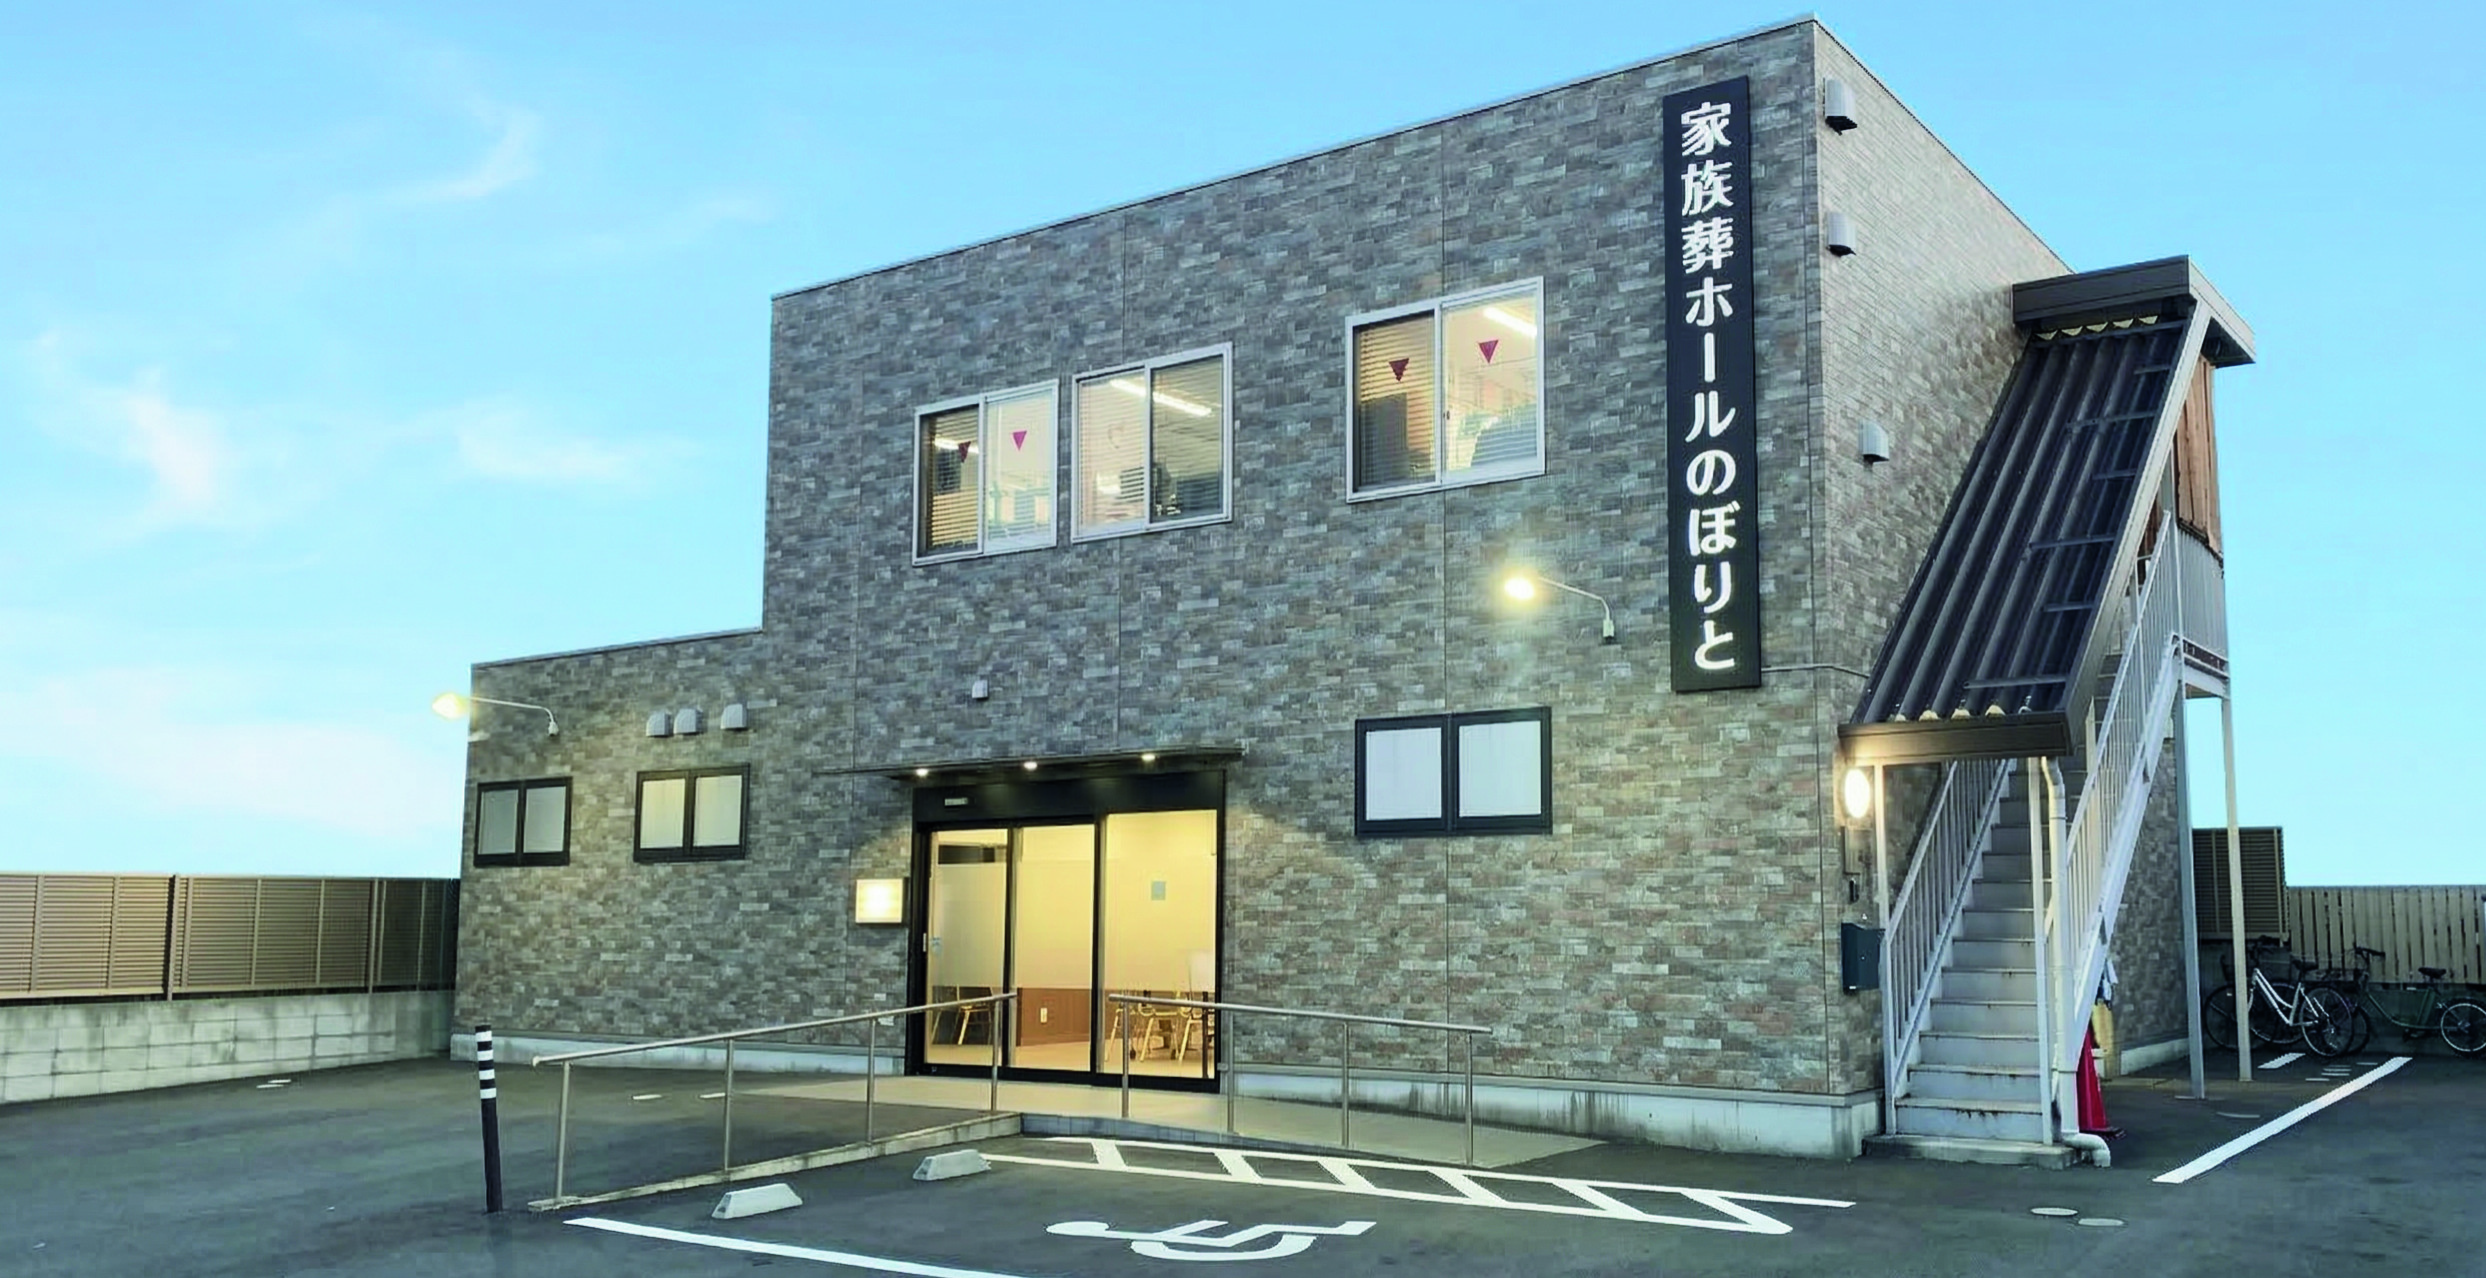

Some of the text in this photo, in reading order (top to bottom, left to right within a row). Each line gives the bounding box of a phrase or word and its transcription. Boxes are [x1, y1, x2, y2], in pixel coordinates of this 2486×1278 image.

[1680, 101, 1740, 670] 家族葬ホールのぼりと
